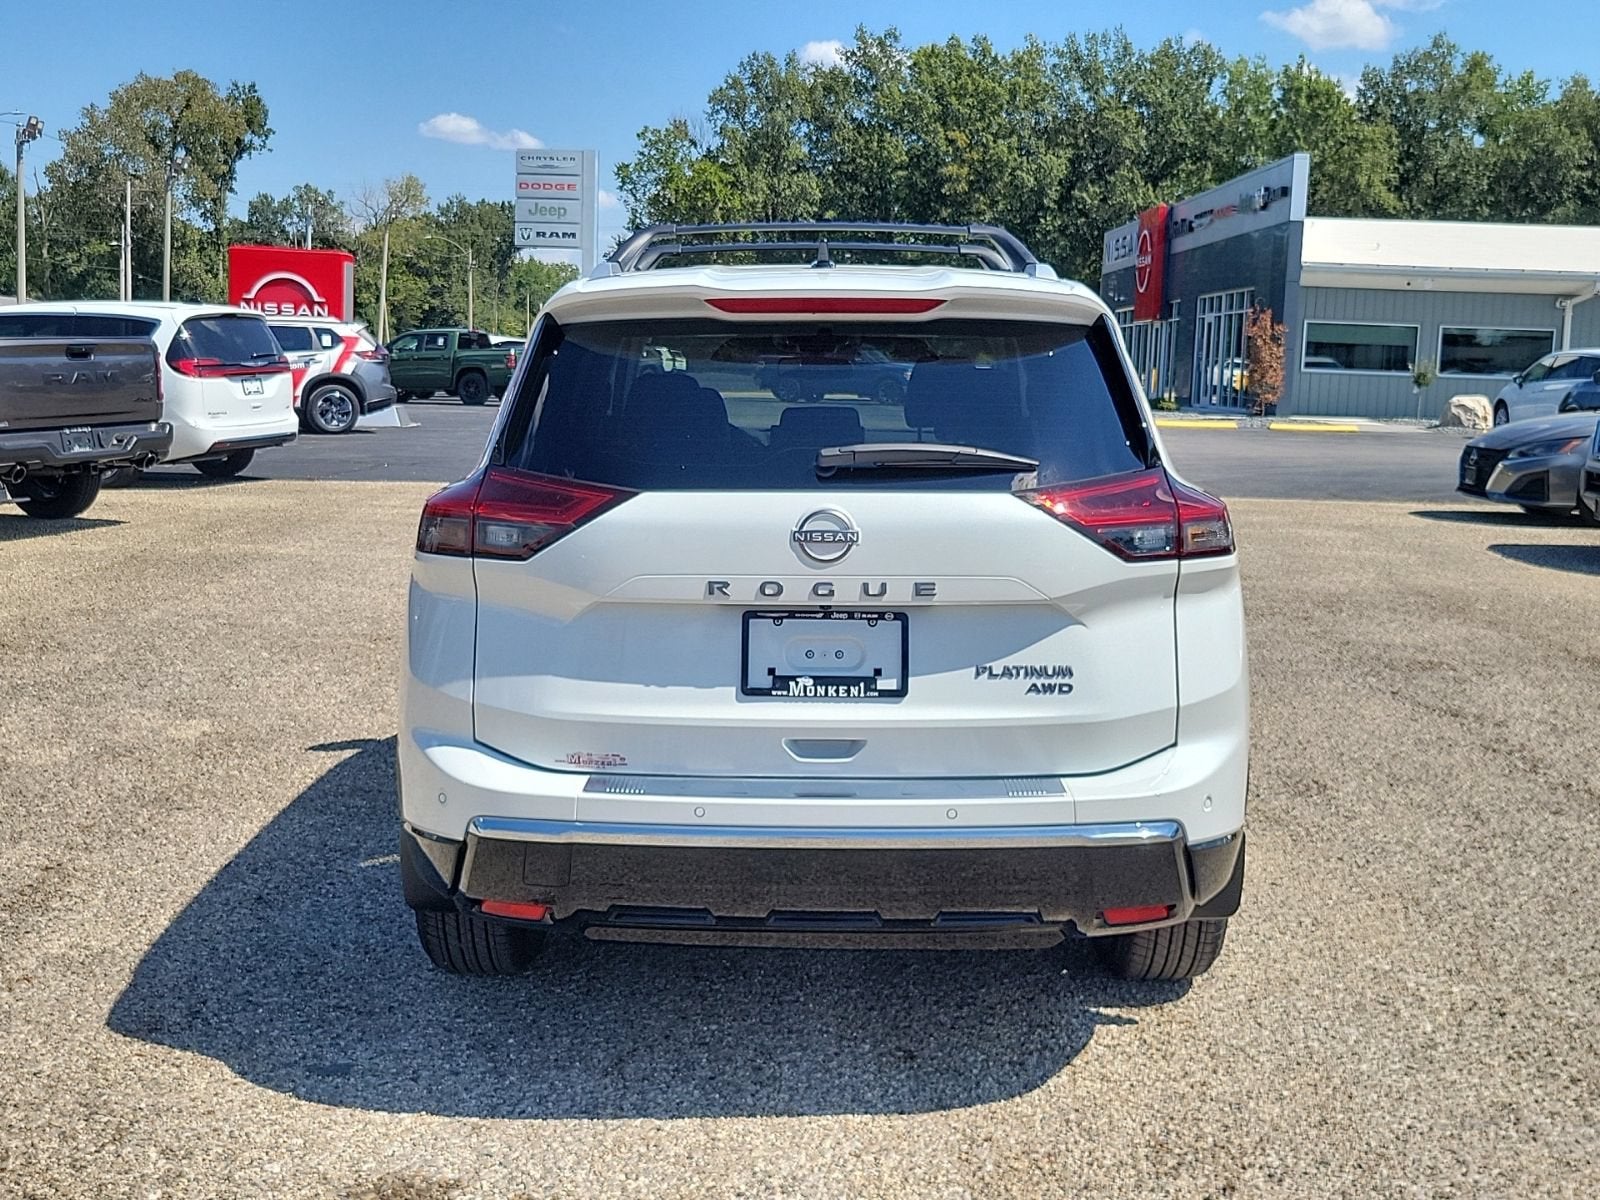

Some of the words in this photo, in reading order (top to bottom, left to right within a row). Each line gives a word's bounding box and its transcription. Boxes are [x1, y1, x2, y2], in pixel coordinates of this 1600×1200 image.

[519, 182, 577, 191] DODGE
[528, 202, 567, 219] Jeep
[535, 231, 577, 239] RAM
[239, 300, 329, 317] NISSAN
[793, 531, 858, 543] NISSAN
[707, 581, 937, 597] ROGUE
[831, 612, 849, 620] Jeep
[974, 664, 1074, 680] PLATINUM
[1024, 682, 1074, 695] AWD
